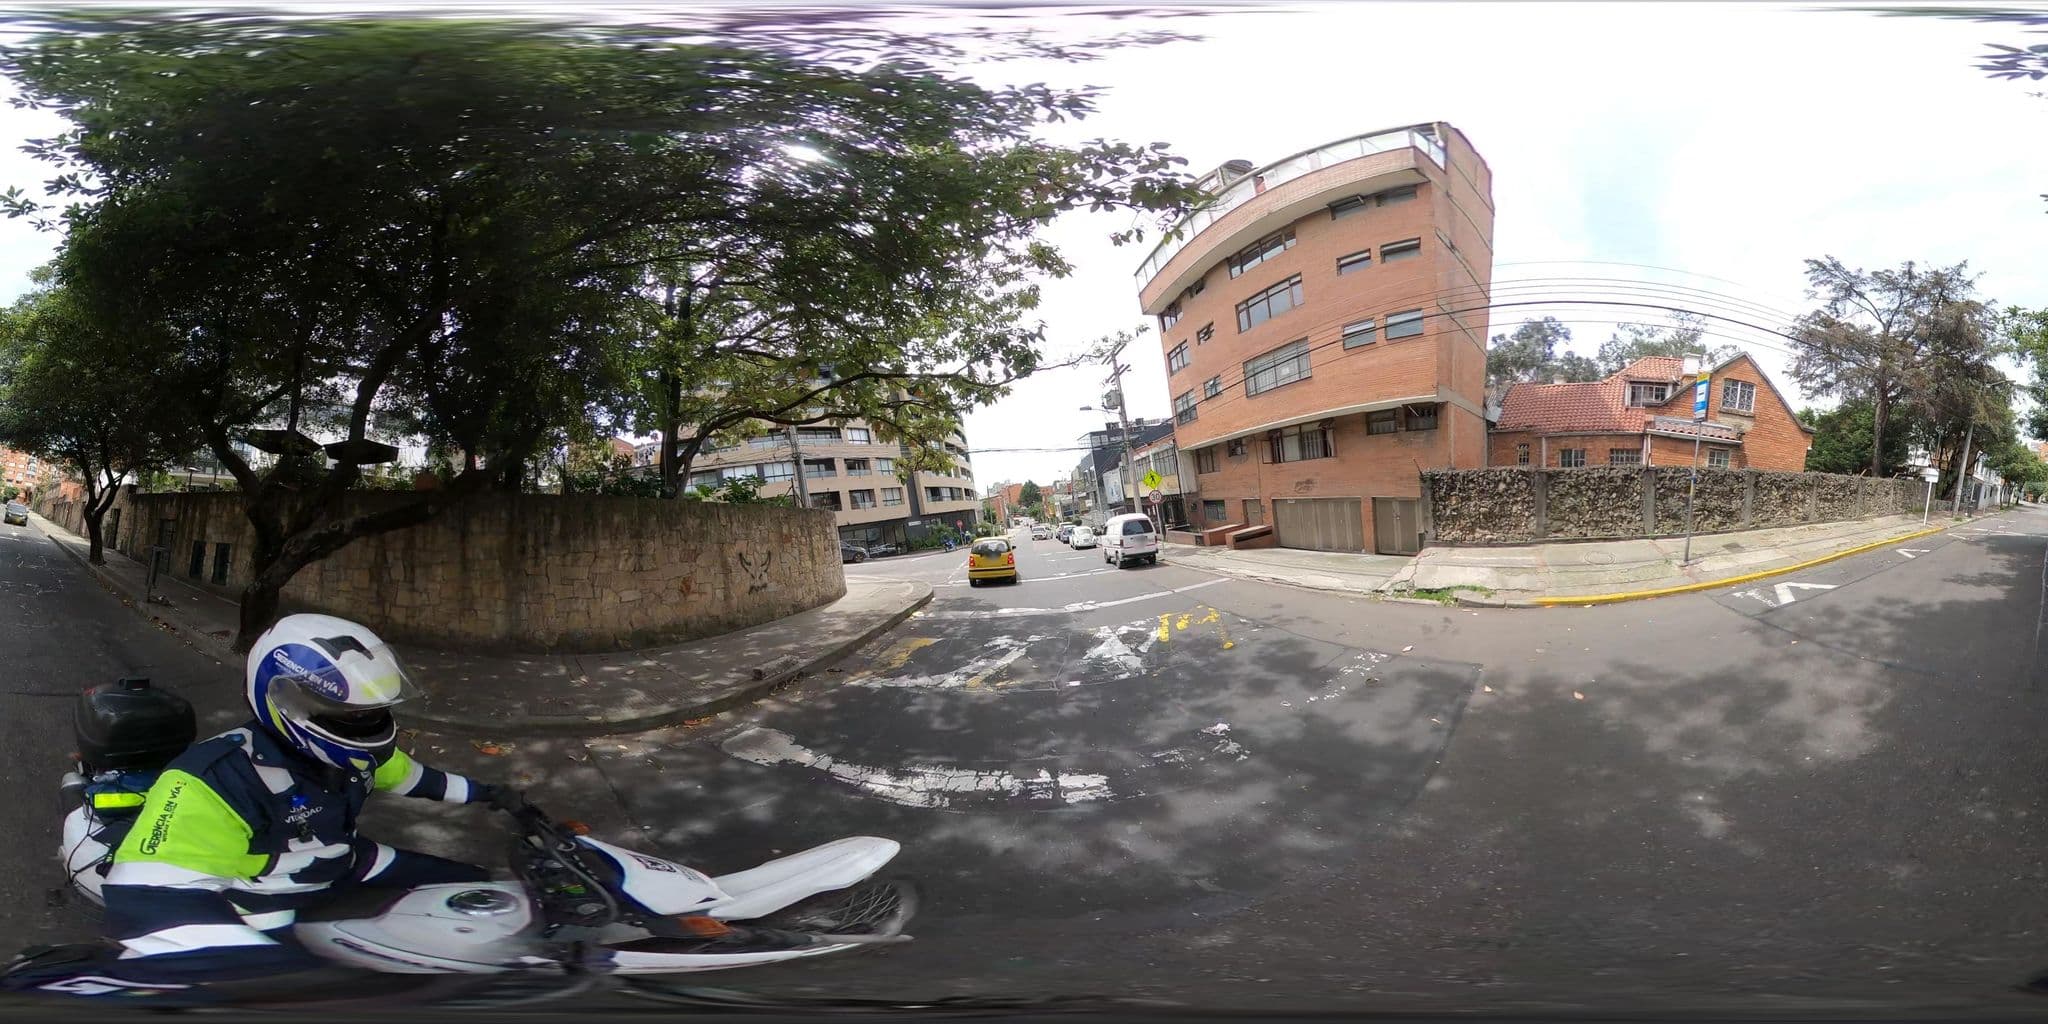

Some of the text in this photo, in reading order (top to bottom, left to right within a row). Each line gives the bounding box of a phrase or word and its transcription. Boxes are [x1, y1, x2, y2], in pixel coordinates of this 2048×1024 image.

[273, 648, 308, 678] GERENCIA
[308, 673, 323, 685] EN
[139, 814, 169, 856] GERENCIA
[163, 800, 175, 812] EN
